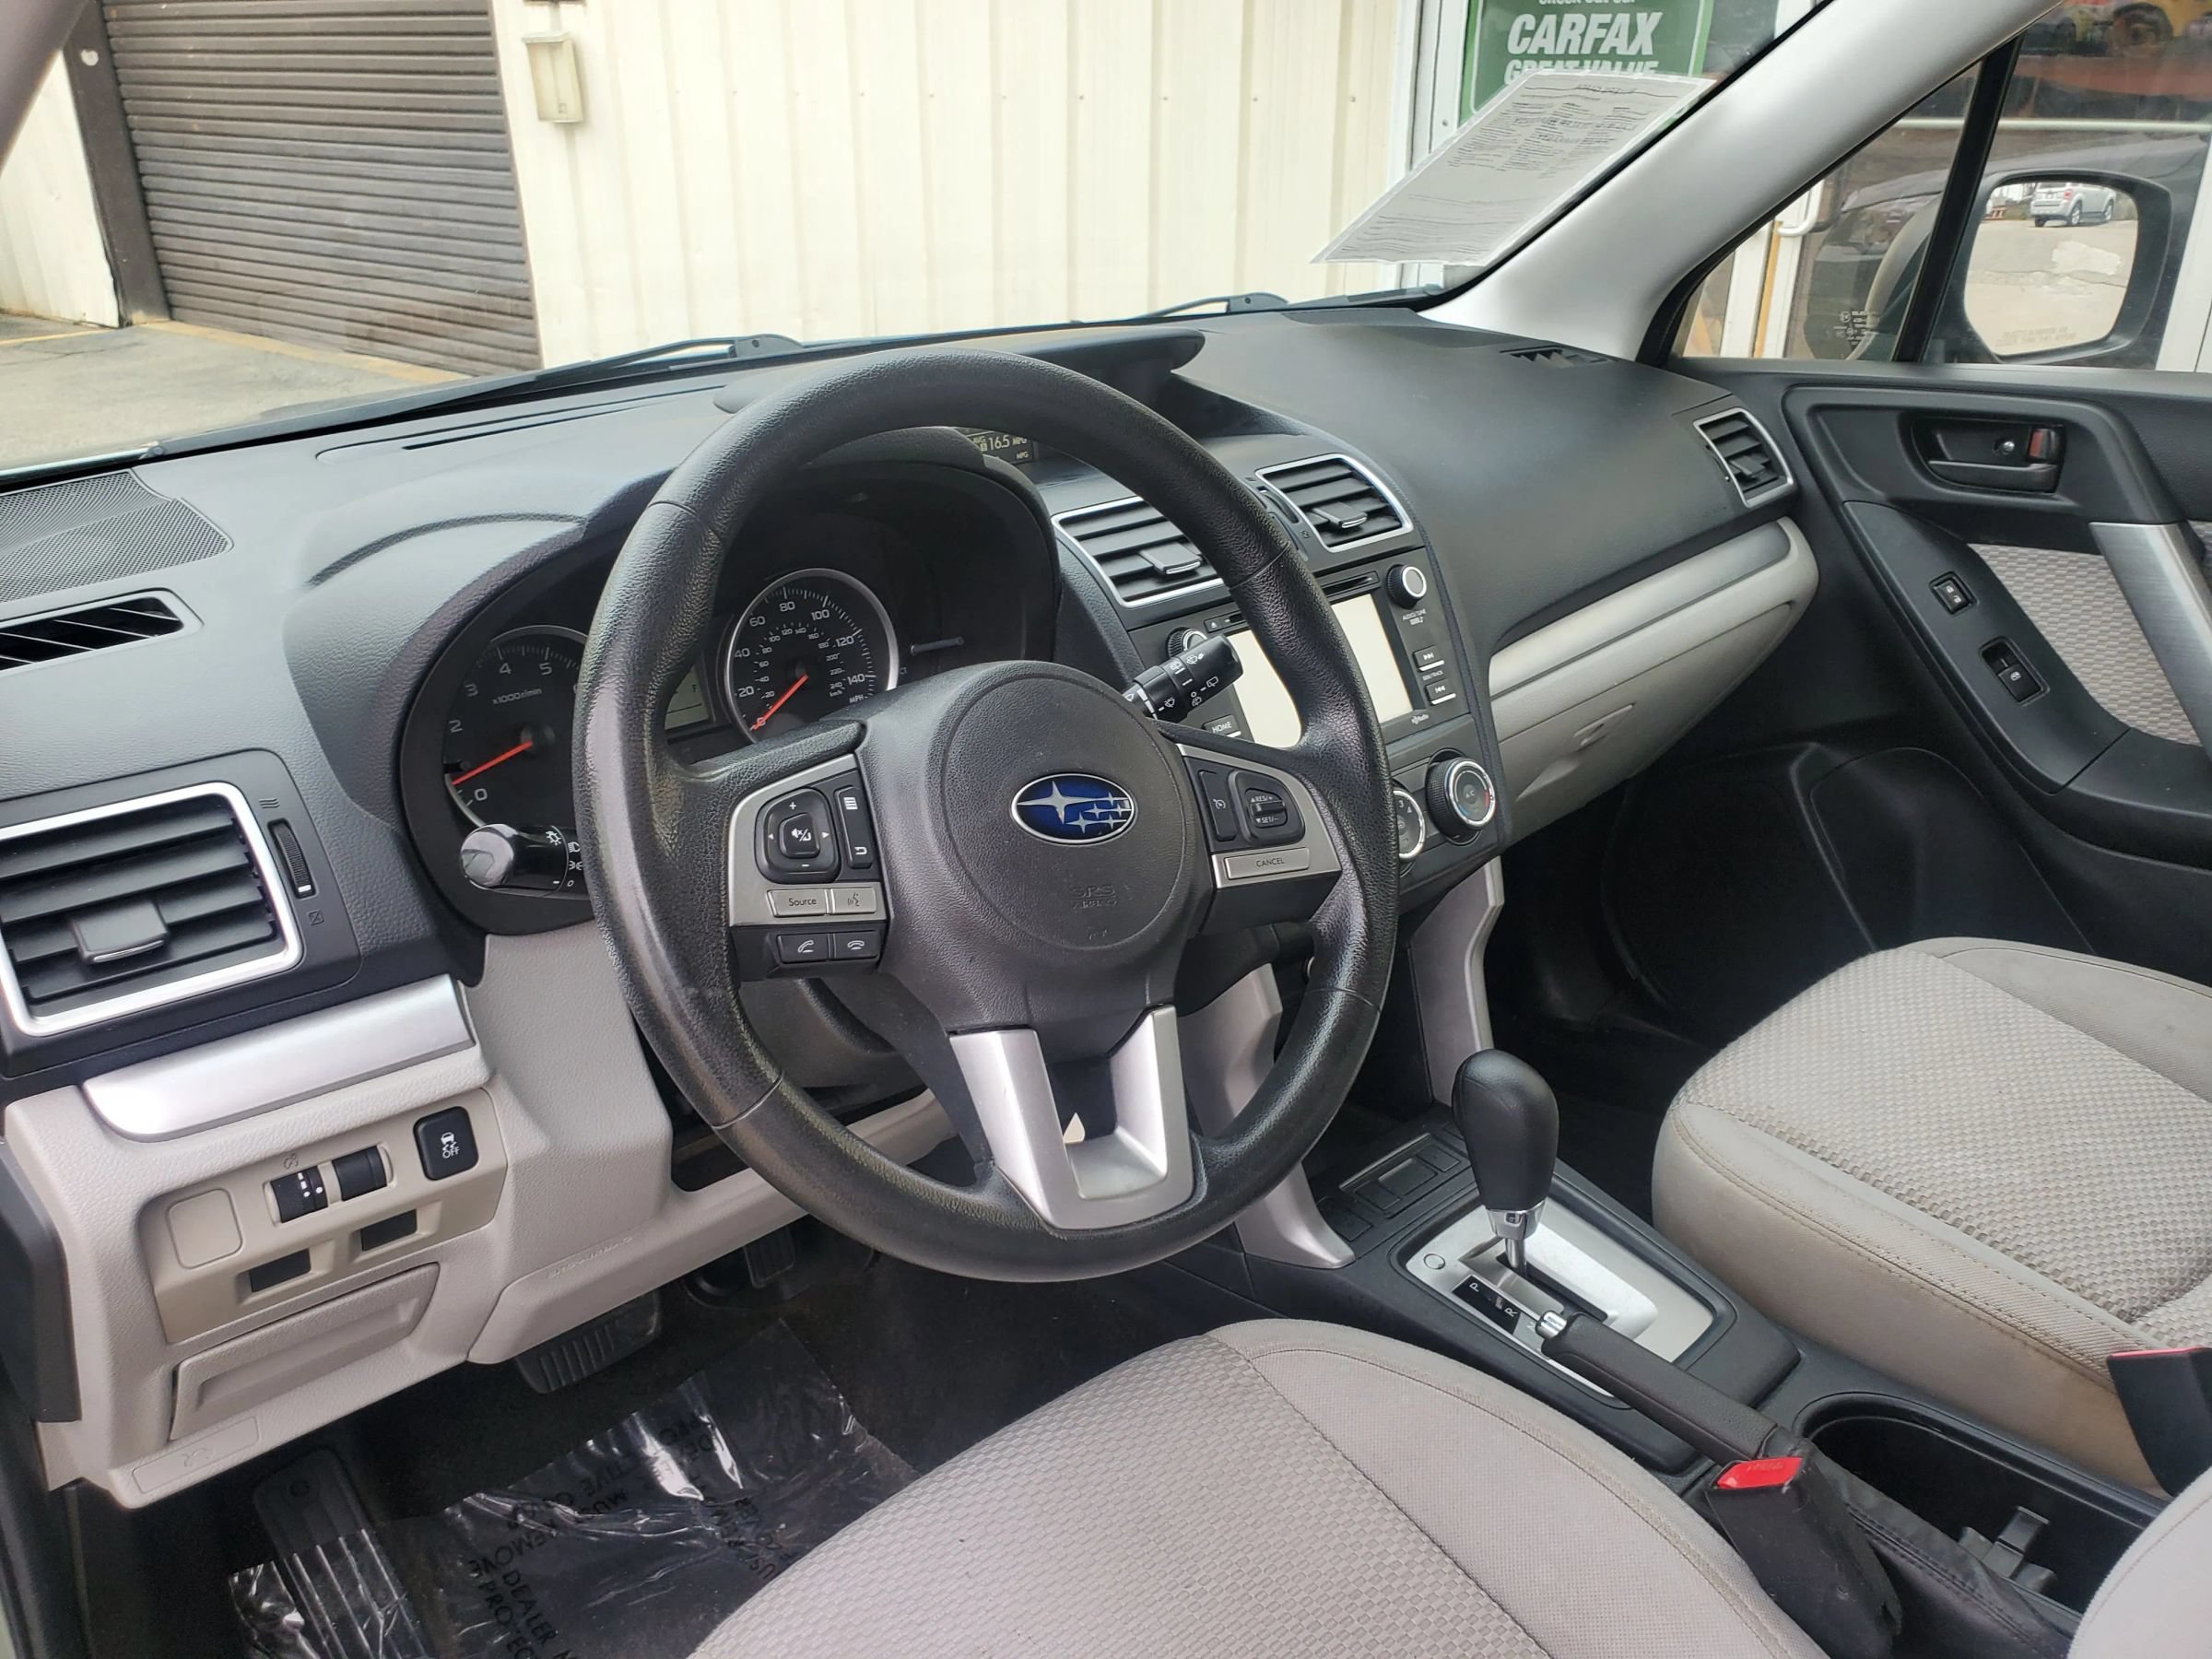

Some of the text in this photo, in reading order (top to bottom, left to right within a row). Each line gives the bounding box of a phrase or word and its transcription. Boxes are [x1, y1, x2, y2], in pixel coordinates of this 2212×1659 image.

[1507, 12, 1663, 55] CARFAX
[779, 601, 795, 612] 80
[811, 609, 830, 620] 100
[749, 616, 766, 627] 60
[835, 636, 854, 647] 120
[735, 648, 750, 658] 40
[499, 663, 512, 675] 4
[540, 662, 552, 676] 5
[847, 673, 865, 685] 140
[465, 684, 478, 697] 3
[738, 686, 754, 698] 20
[449, 720, 463, 733] 2
[1212, 722, 1232, 733] HOME
[474, 788, 488, 801] 0
[1256, 857, 1285, 867] CANCEL
[788, 898, 818, 906] Source
[442, 1146, 460, 1159] OFF
[1469, 1282, 1479, 1292] P
[1504, 1307, 1518, 1317] R
[502, 1570, 557, 1645] DEALER
